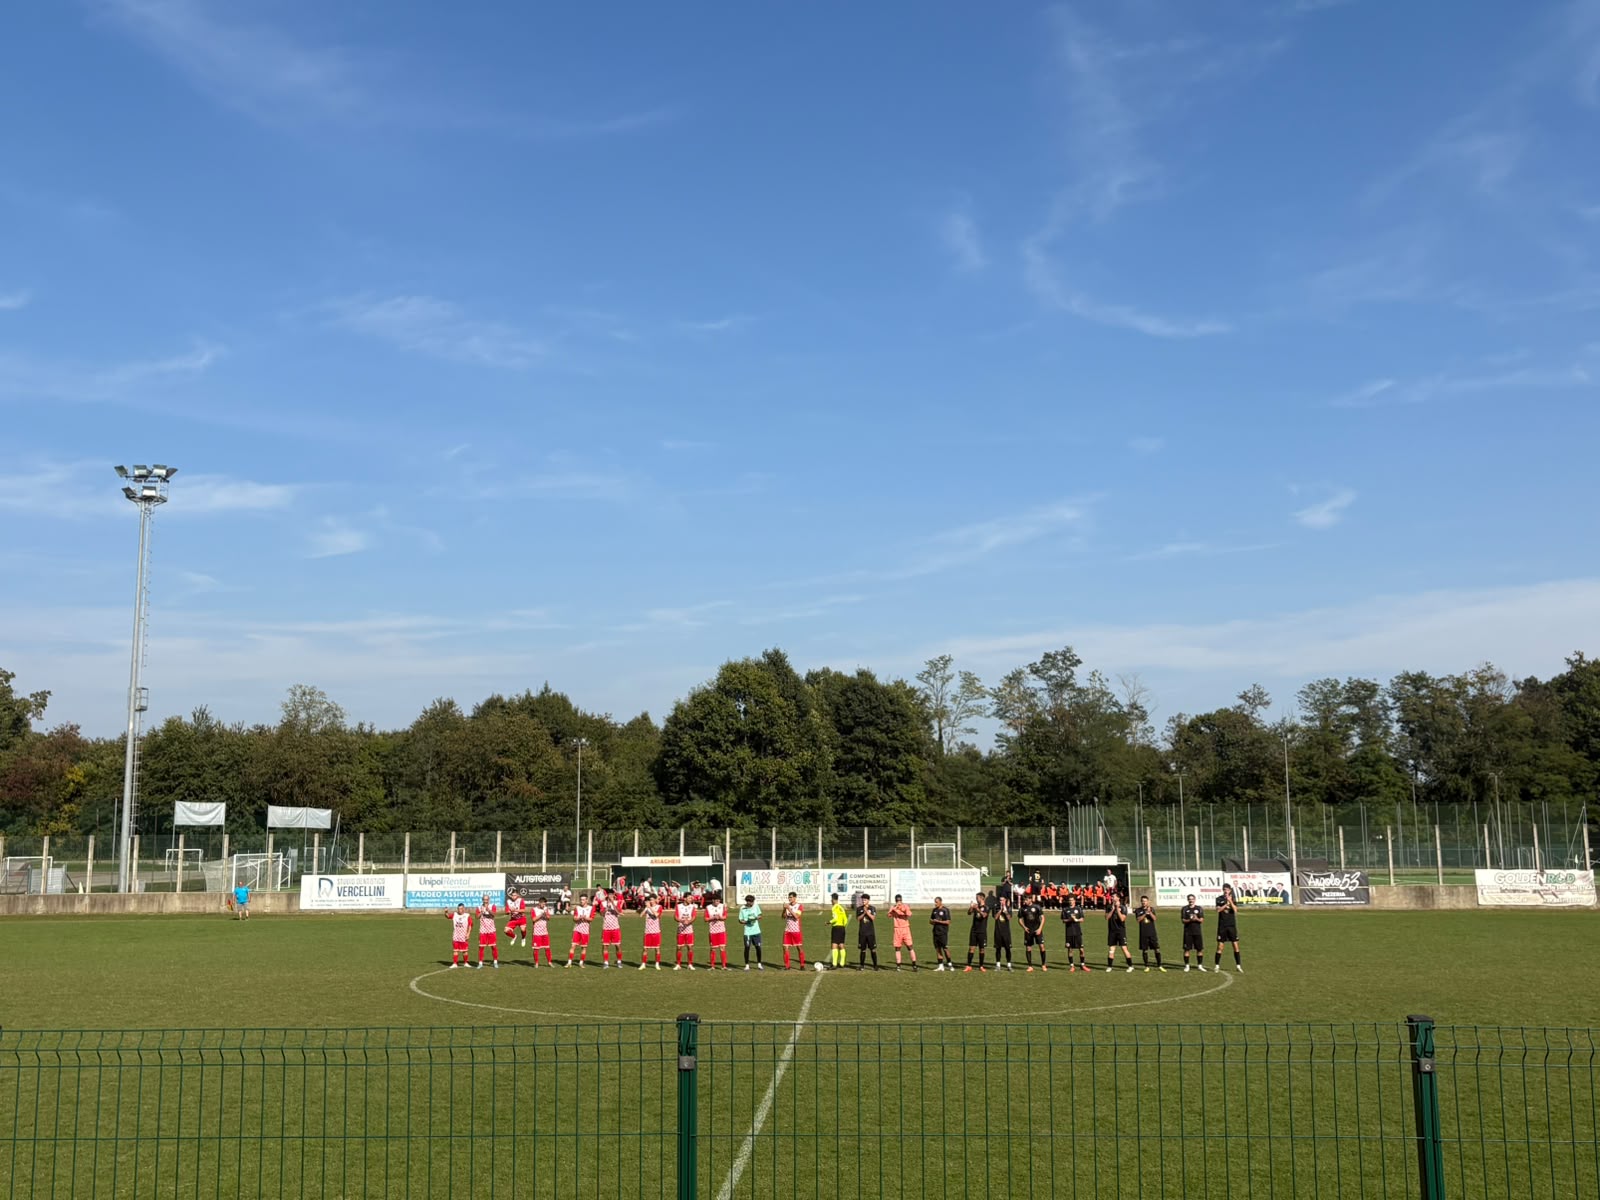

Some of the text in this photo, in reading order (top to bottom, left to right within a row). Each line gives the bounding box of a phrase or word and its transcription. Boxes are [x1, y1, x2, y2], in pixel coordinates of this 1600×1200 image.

[356, 877, 386, 885] DENTISTICO
[419, 876, 471, 887] UnipolRental
[514, 874, 563, 883] AUTOTORINO
[740, 871, 820, 885] MAX SPORT
[1157, 876, 1221, 887] TEXTUM
[1308, 871, 1361, 891] Angolo 53
[337, 885, 386, 897] VERCELLINI
[444, 890, 501, 898] ASSICURAZIONI
